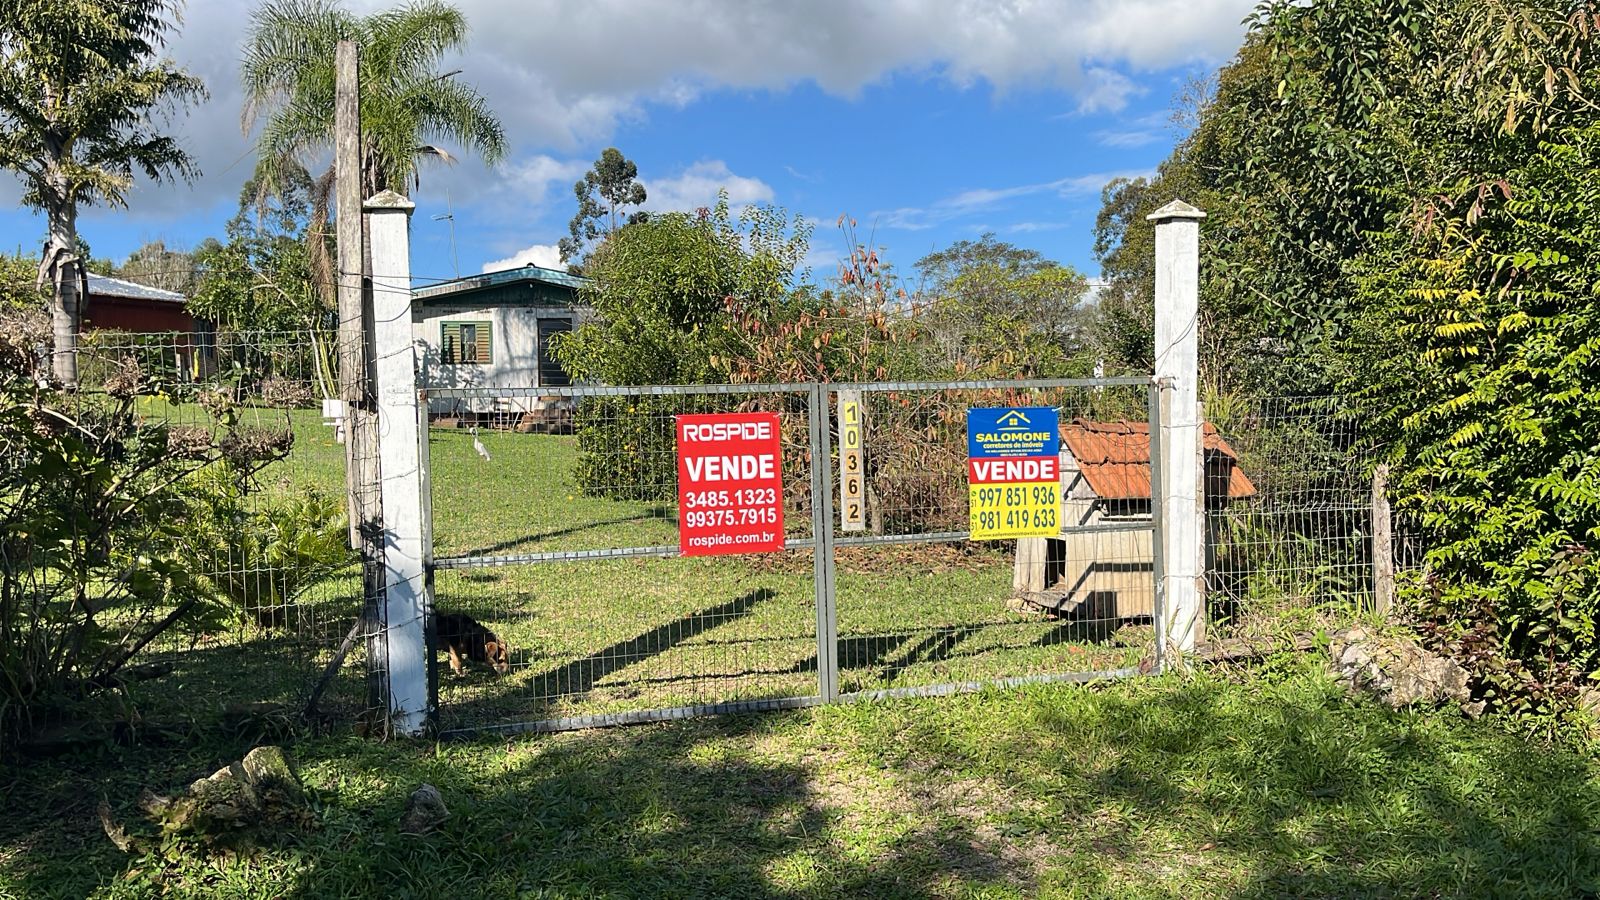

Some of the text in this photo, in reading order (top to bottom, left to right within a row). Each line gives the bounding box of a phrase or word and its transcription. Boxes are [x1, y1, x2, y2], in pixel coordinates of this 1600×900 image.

[683, 422, 770, 442] ROSPIDE
[975, 432, 1051, 442] SALOMONE
[685, 454, 775, 482] VENDE
[973, 460, 1054, 481] VENDE
[686, 488, 776, 508] 3485.1323
[979, 486, 1055, 507] 997 851 936
[686, 507, 777, 528] 99375.7915
[979, 508, 1056, 530] 981 419 633
[689, 531, 775, 548] rospide.com.br
